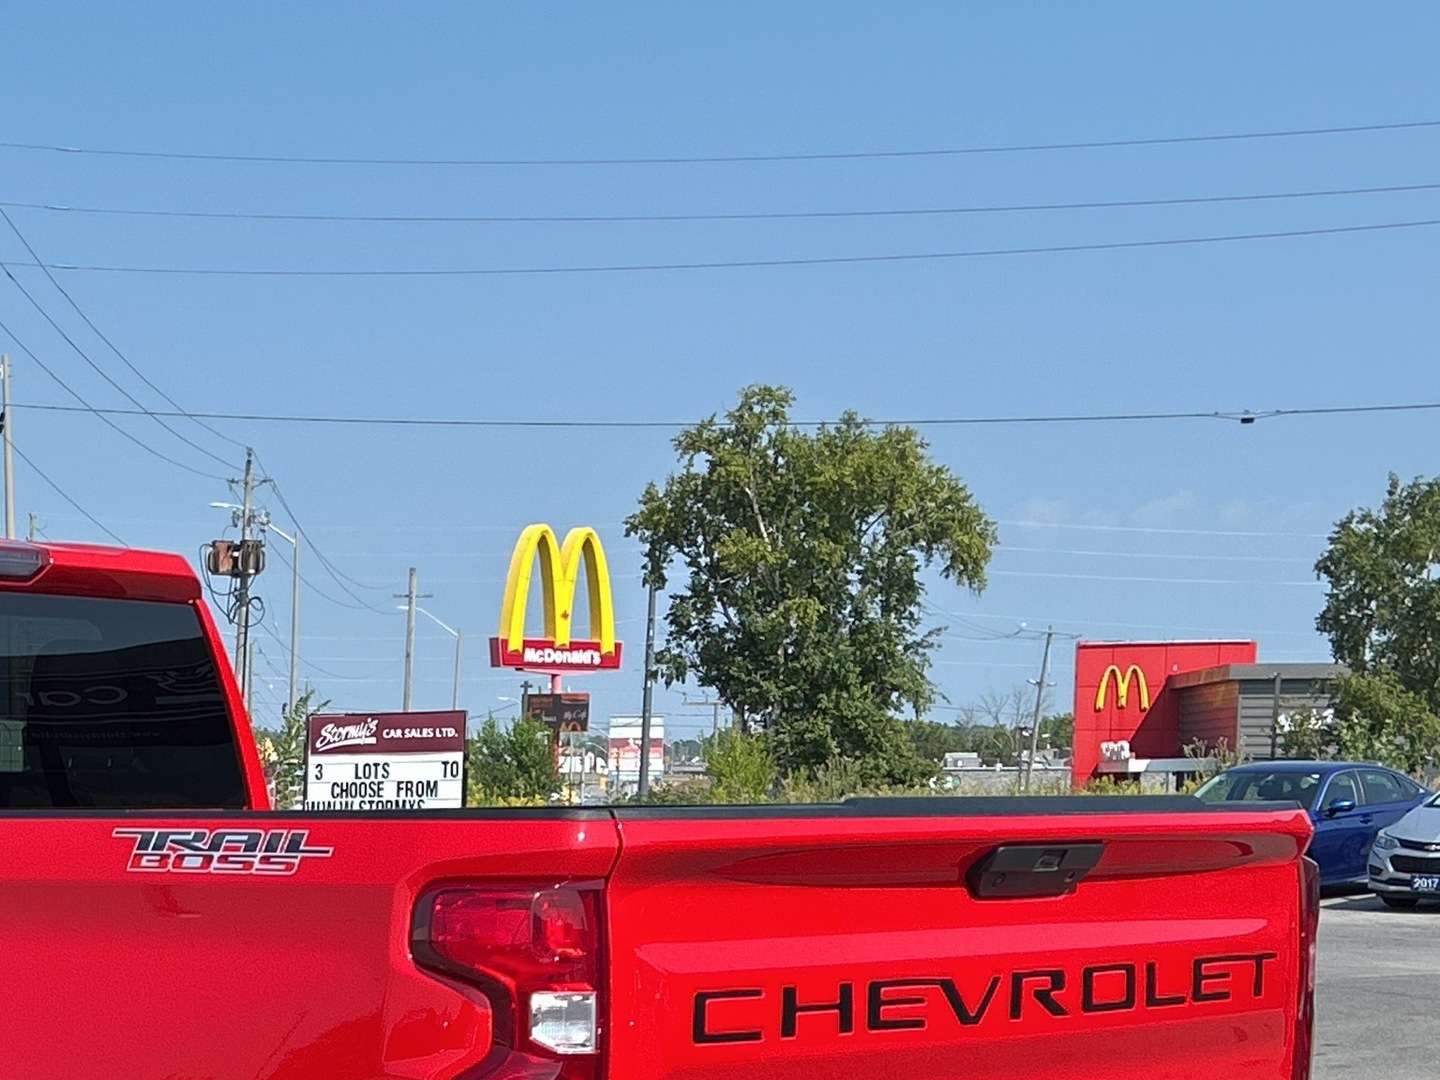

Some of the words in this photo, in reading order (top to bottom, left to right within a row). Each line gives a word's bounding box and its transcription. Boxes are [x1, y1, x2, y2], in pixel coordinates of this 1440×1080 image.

[523, 647, 602, 666] McDonald's
[315, 717, 379, 748] Stormy's
[383, 728, 403, 739] CAR
[404, 727, 434, 739] SALES
[435, 727, 459, 738] LTD.
[314, 763, 324, 780] 3
[354, 762, 390, 780] LOTS
[441, 761, 459, 778] TO
[330, 780, 385, 799] CHOOSE
[396, 779, 439, 798] FROM
[112, 827, 334, 857] TRAIL
[126, 851, 302, 876] BOSS
[1413, 877, 1439, 888] 2017
[692, 952, 1278, 1046] CHEVROLET
